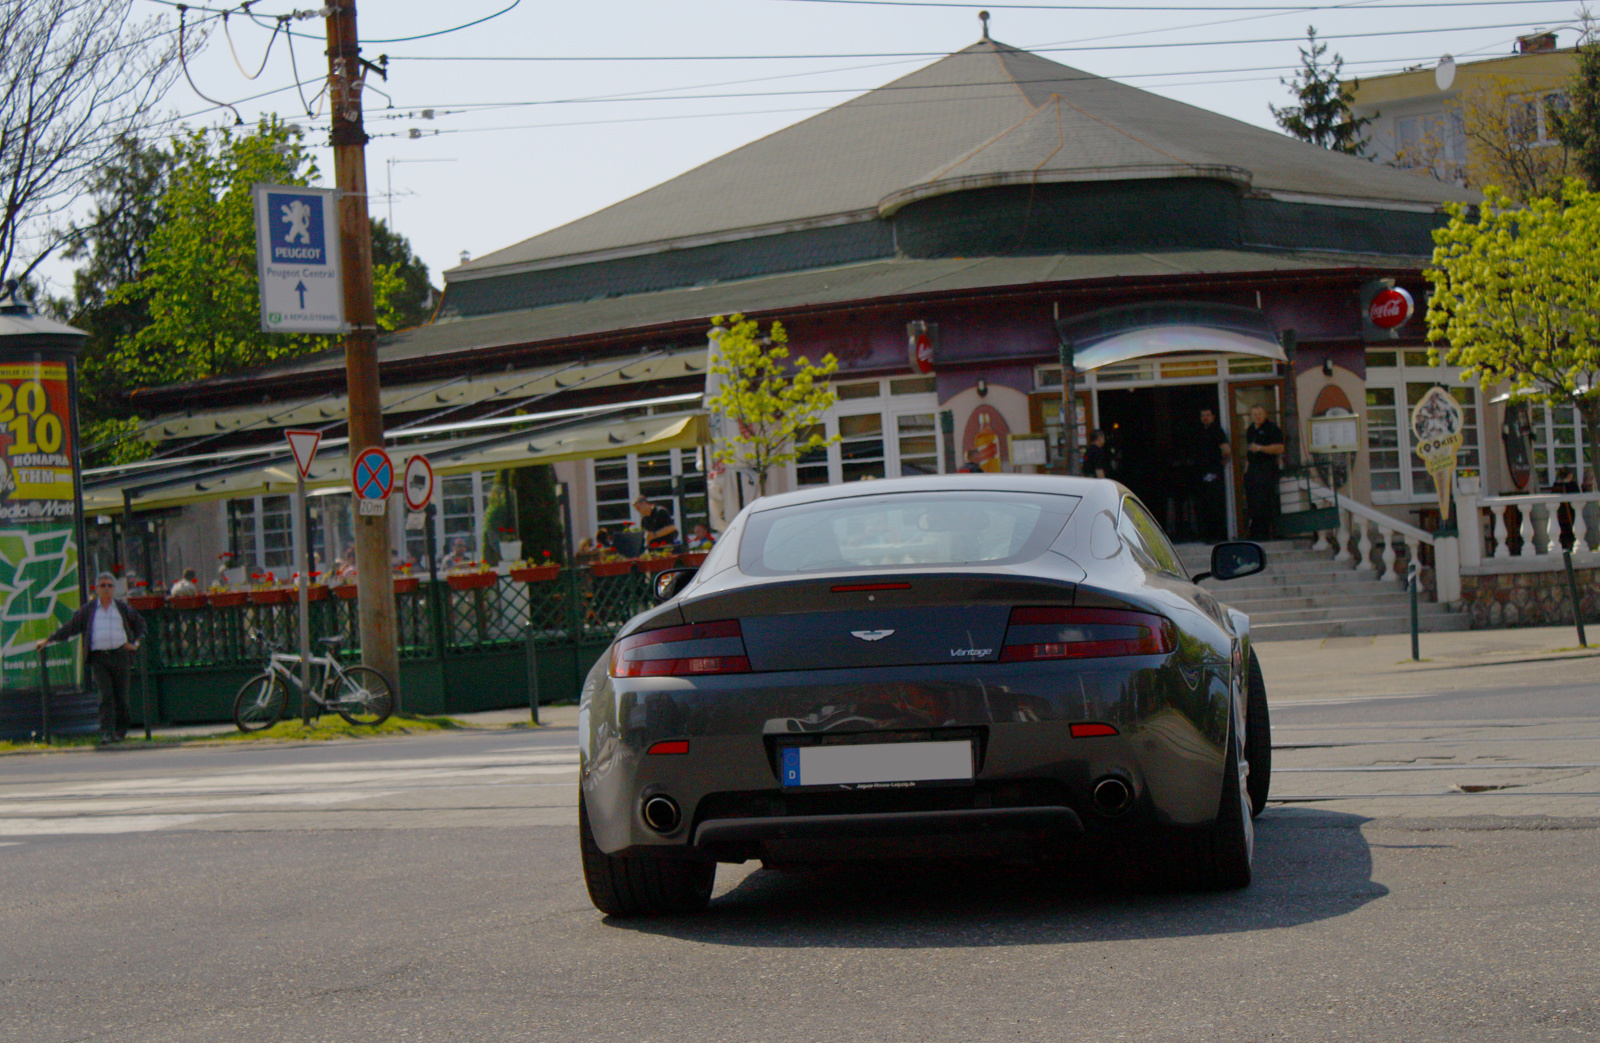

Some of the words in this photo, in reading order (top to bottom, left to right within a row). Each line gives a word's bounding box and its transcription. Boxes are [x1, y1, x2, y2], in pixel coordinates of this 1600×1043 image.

[275, 247, 321, 259] PEUGEOT
[266, 267, 300, 279] Peugeot
[8, 413, 62, 455] 10
[13, 453, 70, 467] HÓNAPRA
[18, 469, 55, 484] THM
[950, 648, 993, 658] Vantage
[789, 770, 796, 780] D
